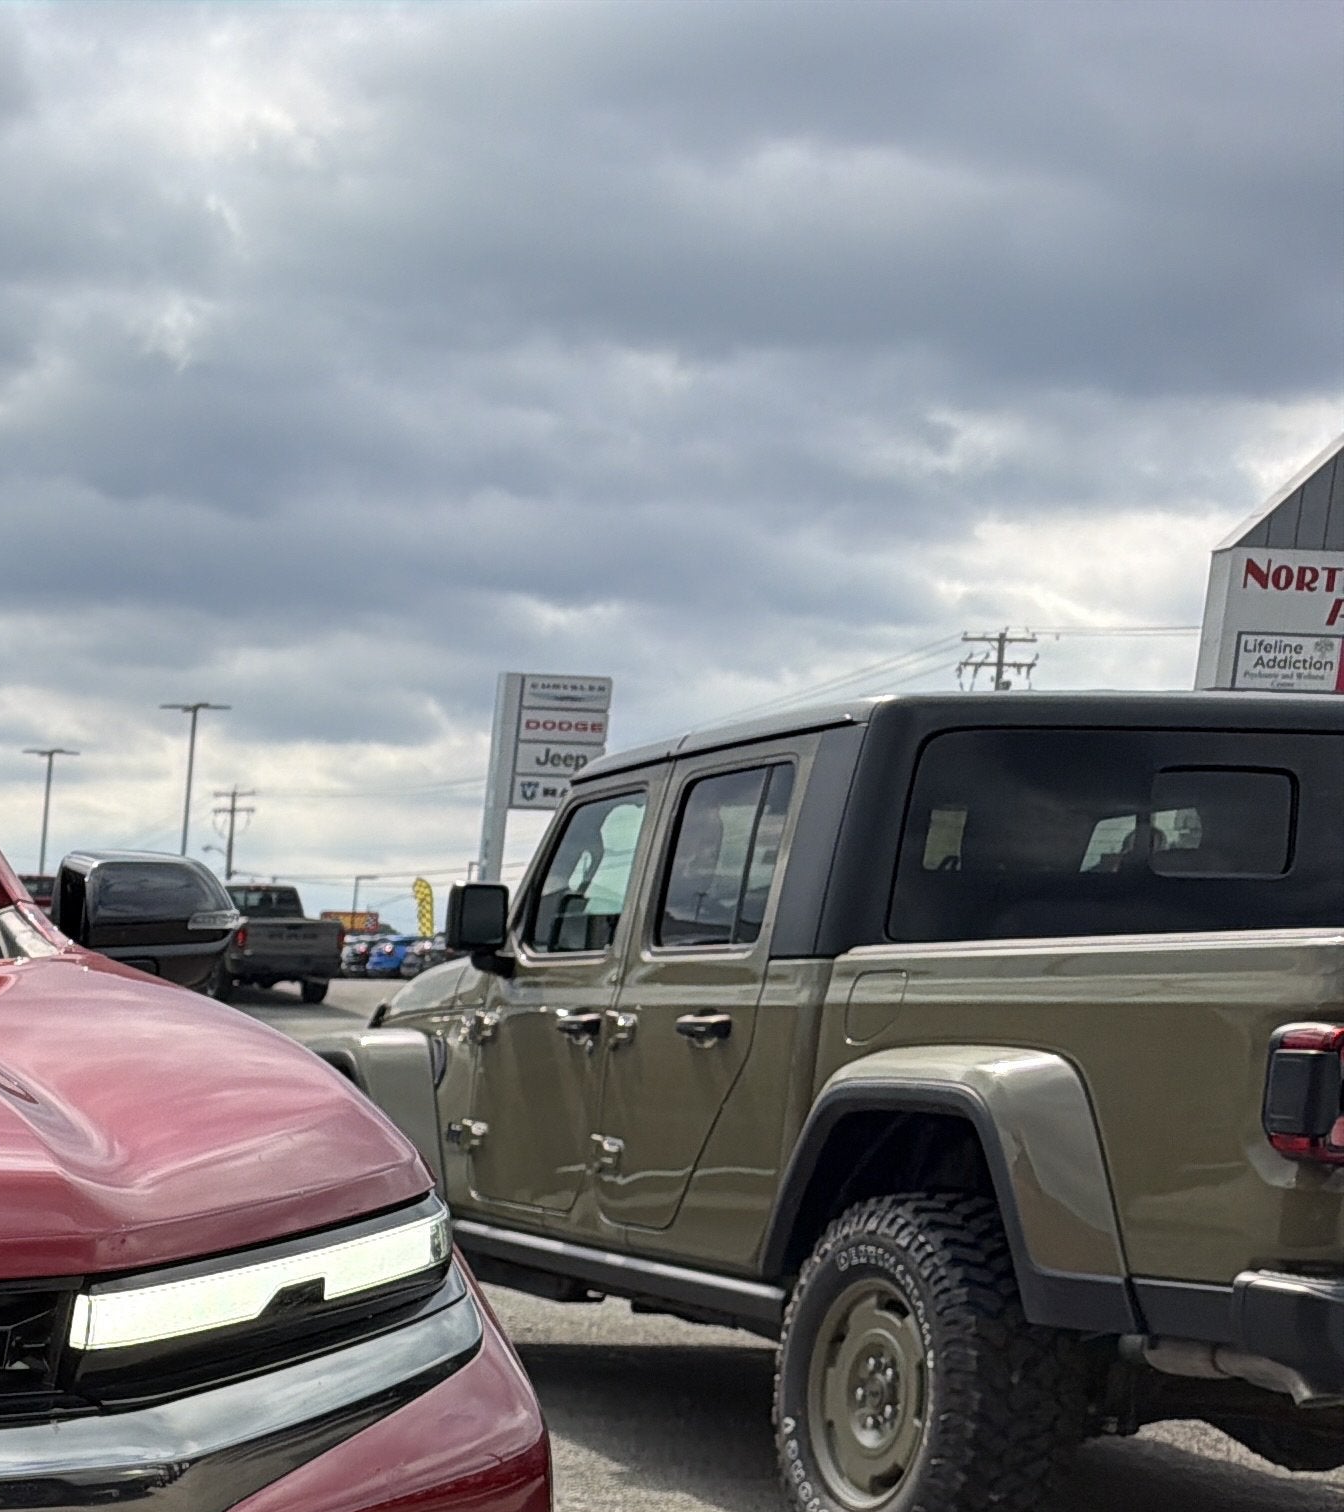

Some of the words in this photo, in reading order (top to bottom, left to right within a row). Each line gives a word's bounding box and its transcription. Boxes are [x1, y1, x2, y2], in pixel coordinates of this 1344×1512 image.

[1242, 557, 1344, 593] NORT
[1243, 638, 1304, 655] Lifeline
[1253, 655, 1334, 672] Addiction
[525, 719, 603, 733] DODGE
[535, 747, 588, 772] Jeep
